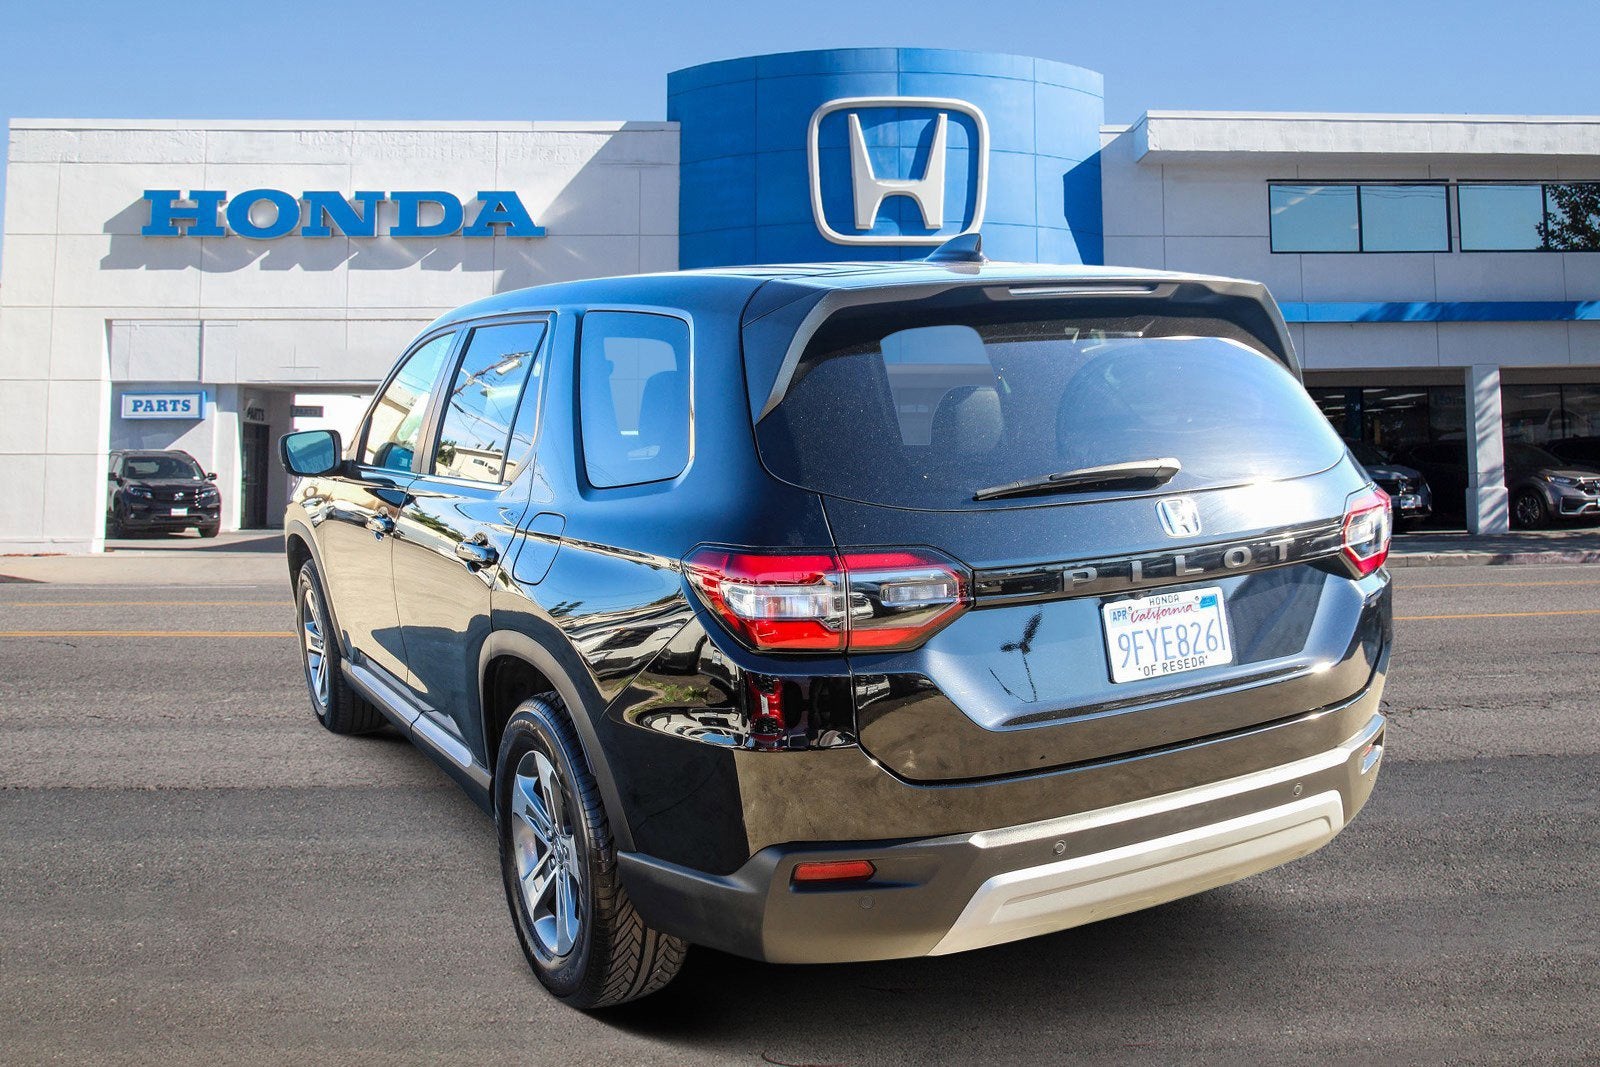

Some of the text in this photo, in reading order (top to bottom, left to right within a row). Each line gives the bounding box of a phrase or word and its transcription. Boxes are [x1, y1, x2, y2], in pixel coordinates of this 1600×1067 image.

[141, 188, 547, 239] HONDA
[131, 399, 191, 412] PARTS
[1062, 537, 1295, 592] PILOT
[1149, 594, 1180, 606] HONDA
[1112, 608, 1128, 622] APR
[1130, 603, 1195, 623] California
[1117, 618, 1218, 669] 9FYE826
[1143, 656, 1206, 677] OF RESEDA
